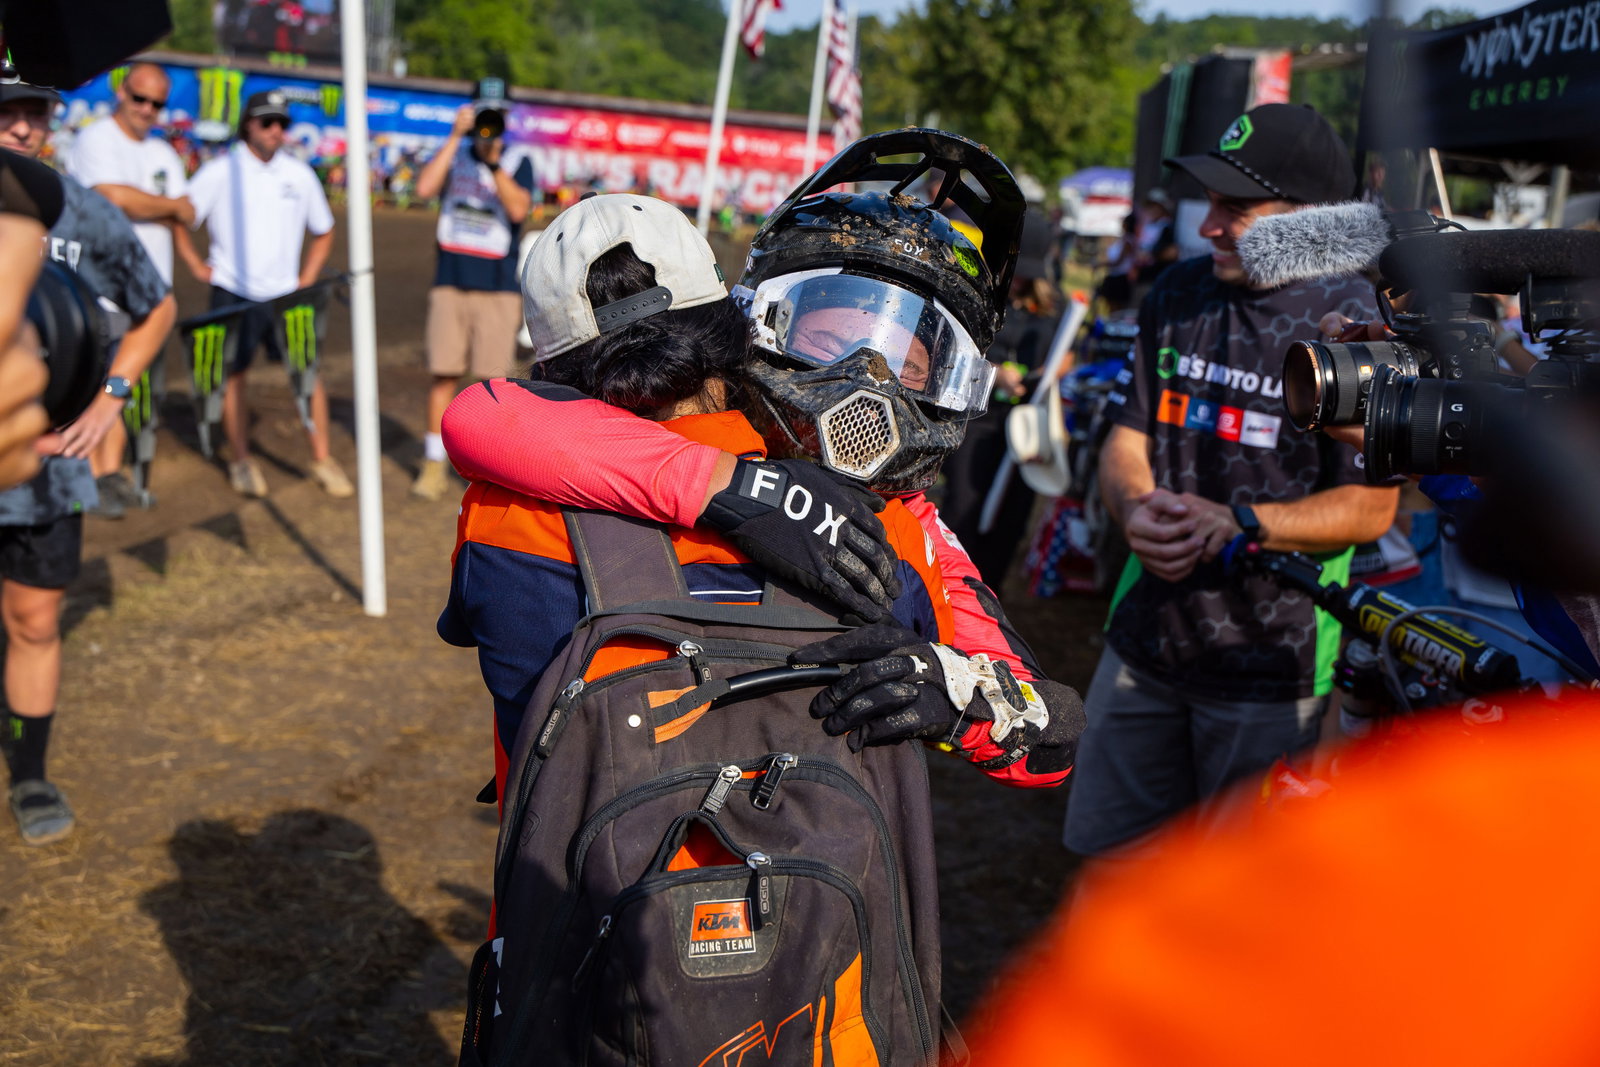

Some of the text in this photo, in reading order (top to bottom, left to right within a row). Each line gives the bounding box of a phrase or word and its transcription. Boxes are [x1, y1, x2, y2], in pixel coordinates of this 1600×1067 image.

[1459, 2, 1600, 78] MONSTER
[1468, 73, 1568, 110] ENERGY
[1205, 362, 1260, 393] MOTO
[1450, 403, 1464, 412] G
[750, 468, 847, 546] FOX
[698, 912, 740, 931] KTM
[690, 938, 753, 954] RACING TEAM
